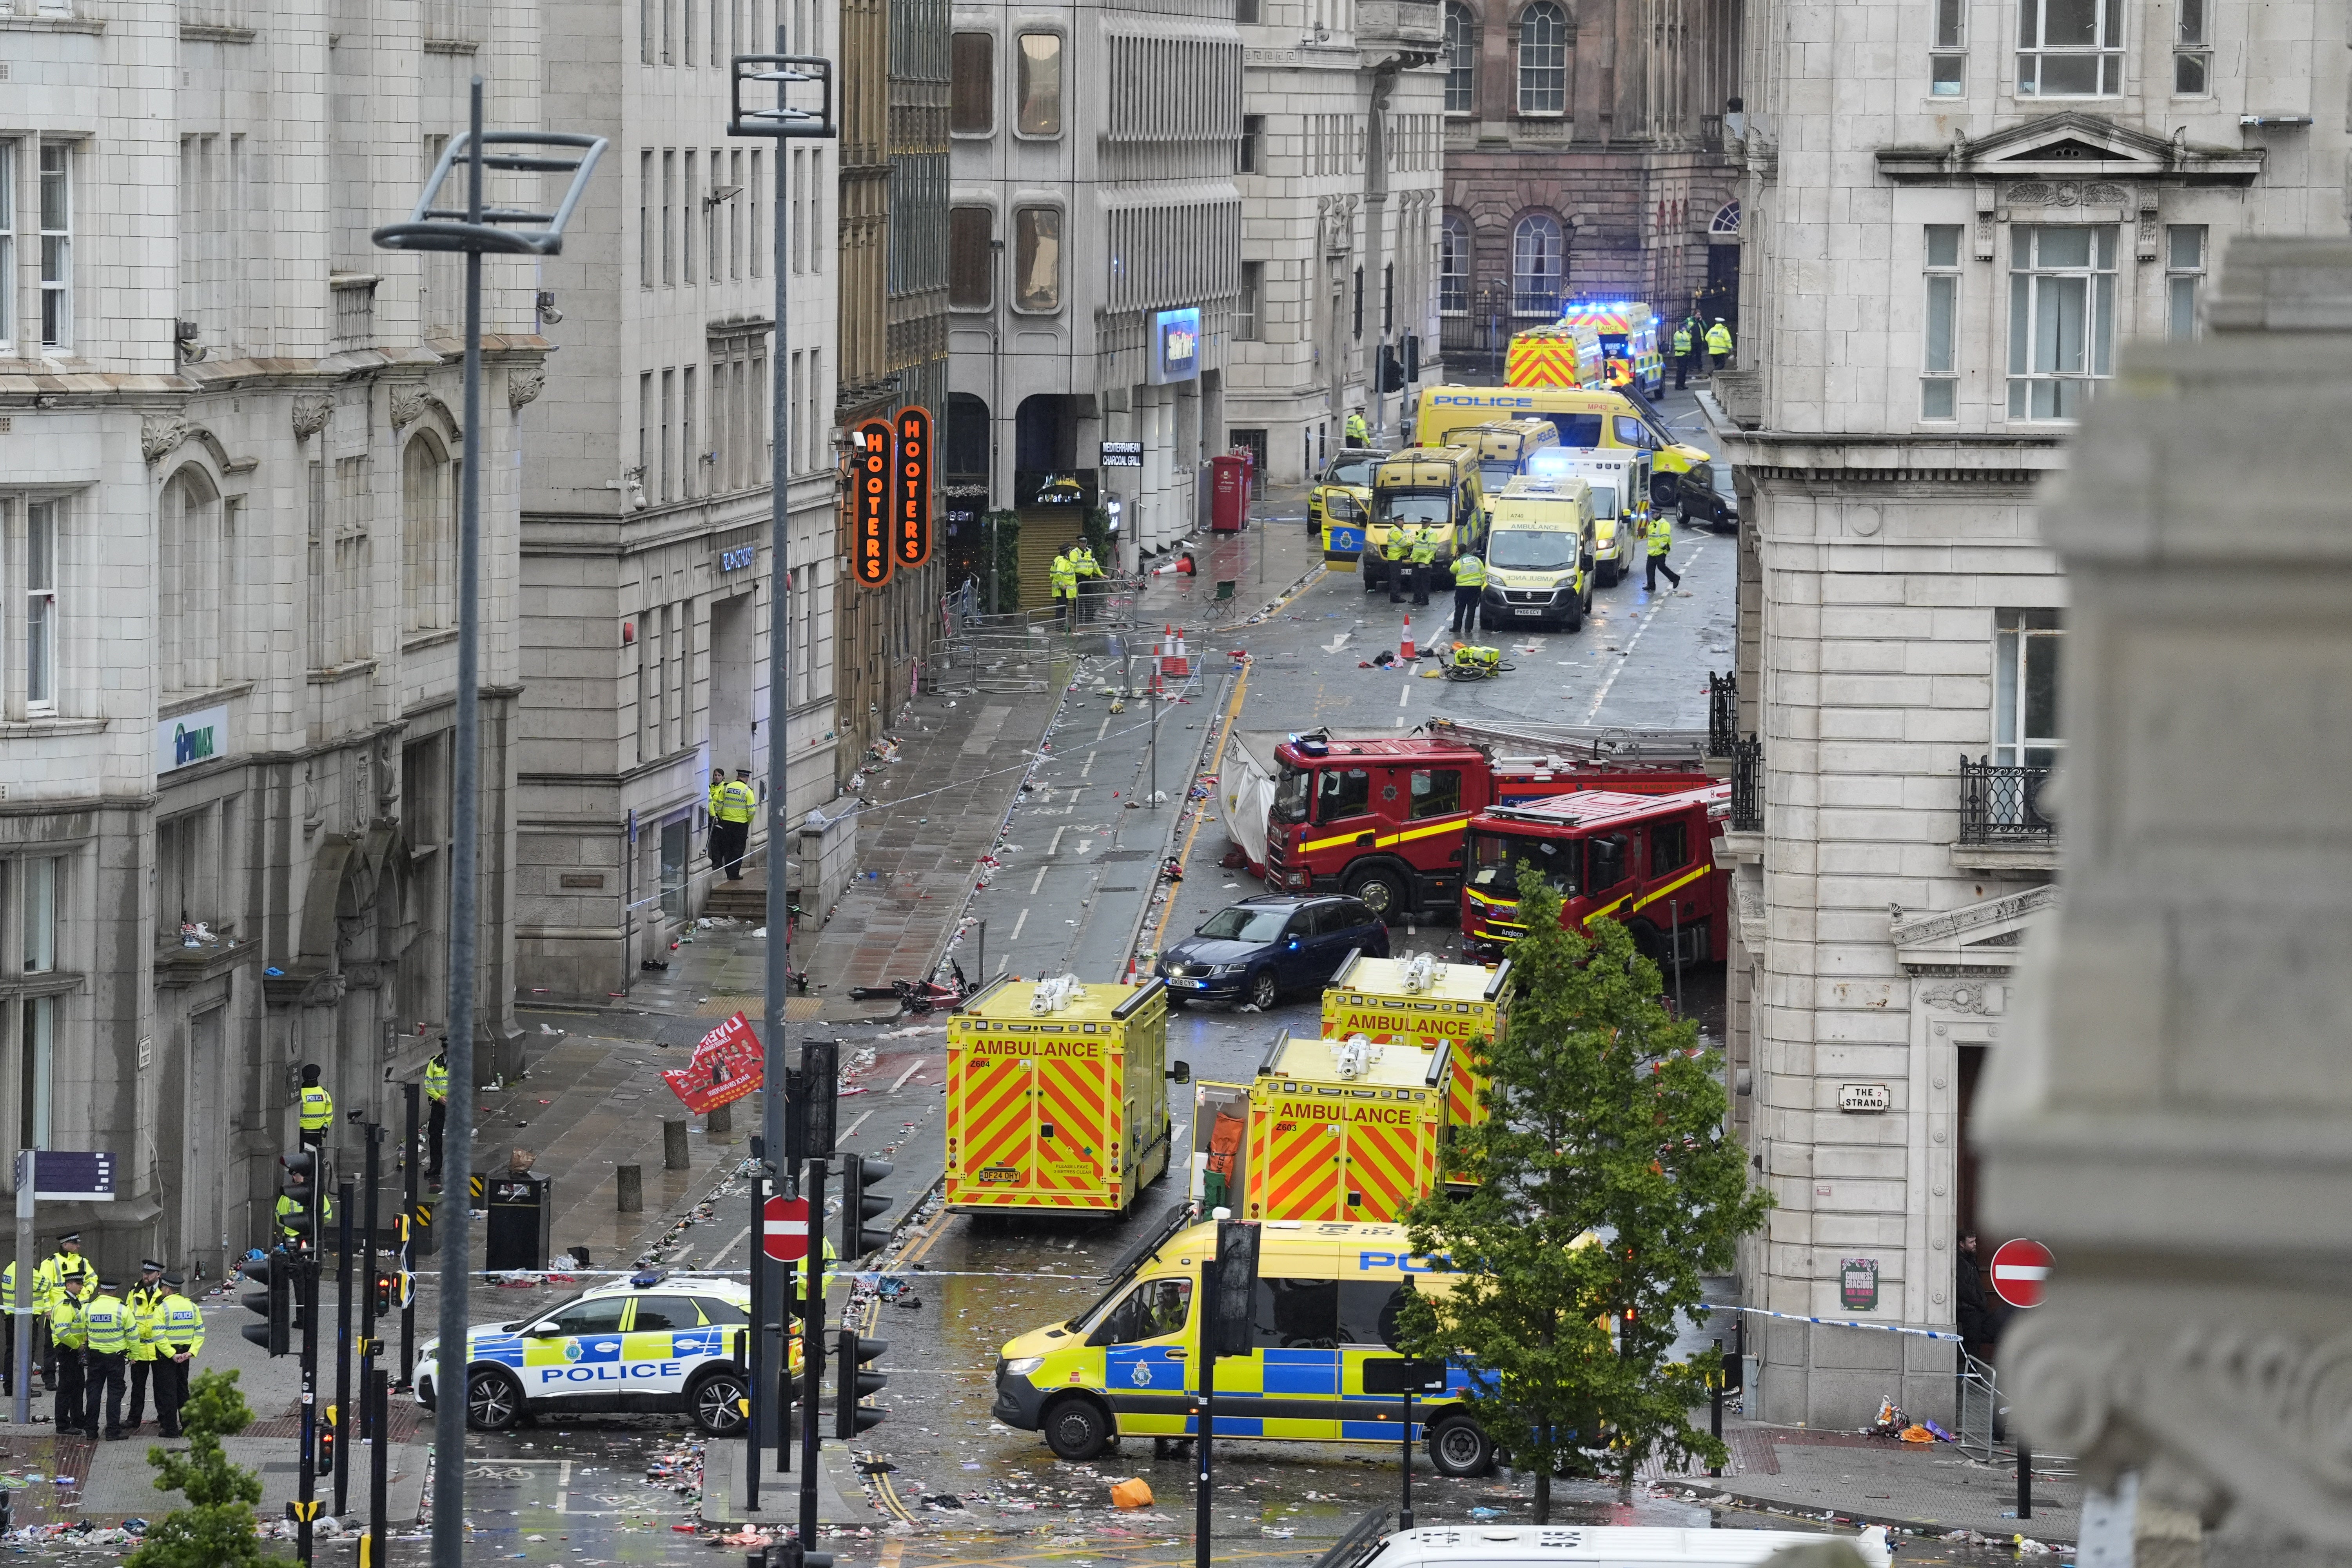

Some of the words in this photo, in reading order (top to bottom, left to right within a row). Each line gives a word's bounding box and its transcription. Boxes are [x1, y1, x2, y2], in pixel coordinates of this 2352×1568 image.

[1434, 396, 1532, 407] POLICE
[1103, 442, 1140, 452] MEDITERRANEAN
[1103, 455, 1127, 466] CHARCOAL
[1127, 456, 1141, 466] GRILL
[905, 421, 920, 558] HOOTERS
[867, 434, 882, 578] HOOTERS
[176, 724, 214, 765] OPTIMAX
[1710, 789, 1715, 798] 8
[1501, 929, 1524, 938] Angloco
[1347, 1014, 1469, 1036] AMBULANCE
[974, 1040, 1098, 1057] AMBULANCE
[1280, 1102, 1411, 1124] AMBULANCE
[1845, 1271, 1874, 1280] GOODNESS
[855, 1279, 874, 1288] Coor
[1845, 1280, 1873, 1289] GRACIOUS
[542, 1363, 682, 1383] POLICE
